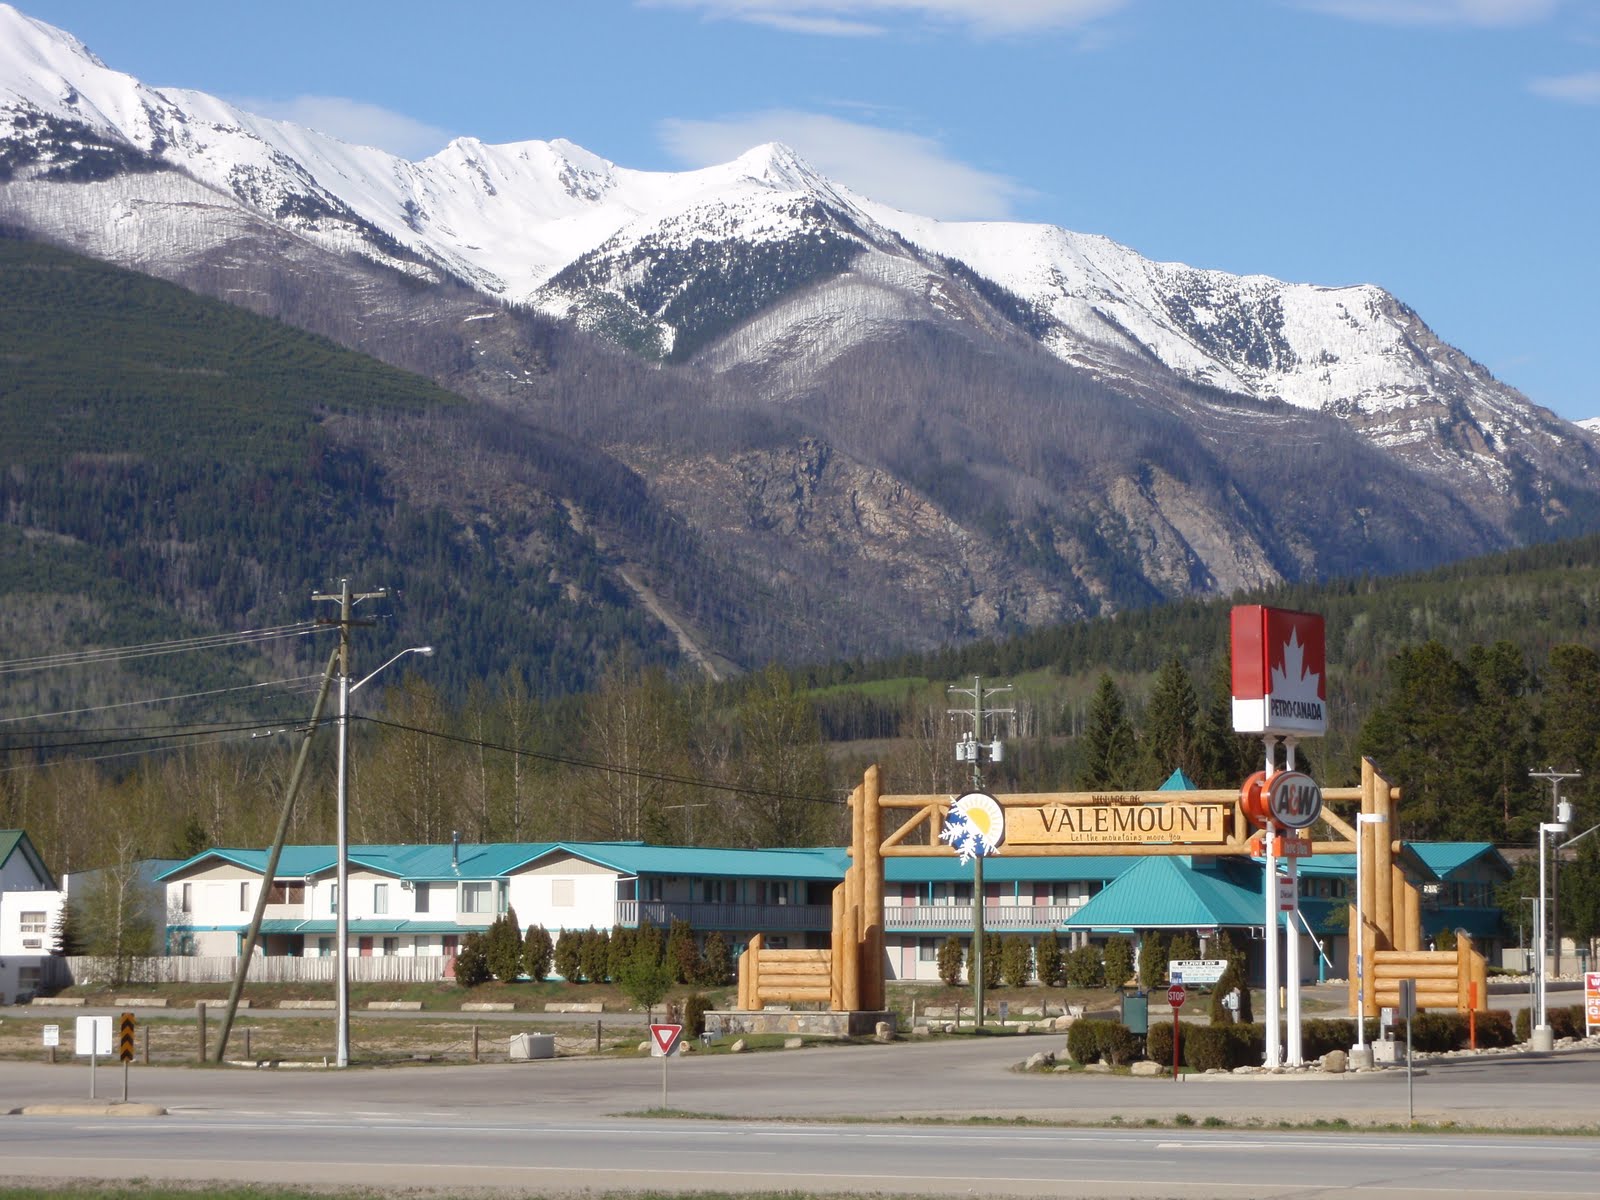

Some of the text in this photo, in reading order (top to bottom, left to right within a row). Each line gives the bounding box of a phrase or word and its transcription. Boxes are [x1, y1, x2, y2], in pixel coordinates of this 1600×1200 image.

[1271, 698, 1322, 721] PETRO-CANADA
[1277, 784, 1317, 816] A&W
[1037, 807, 1217, 832] VALEMOUNT
[1071, 832, 1082, 842] Let
[1086, 832, 1099, 842] the
[1101, 832, 1143, 842] mountains
[1168, 991, 1185, 1000] STOP
